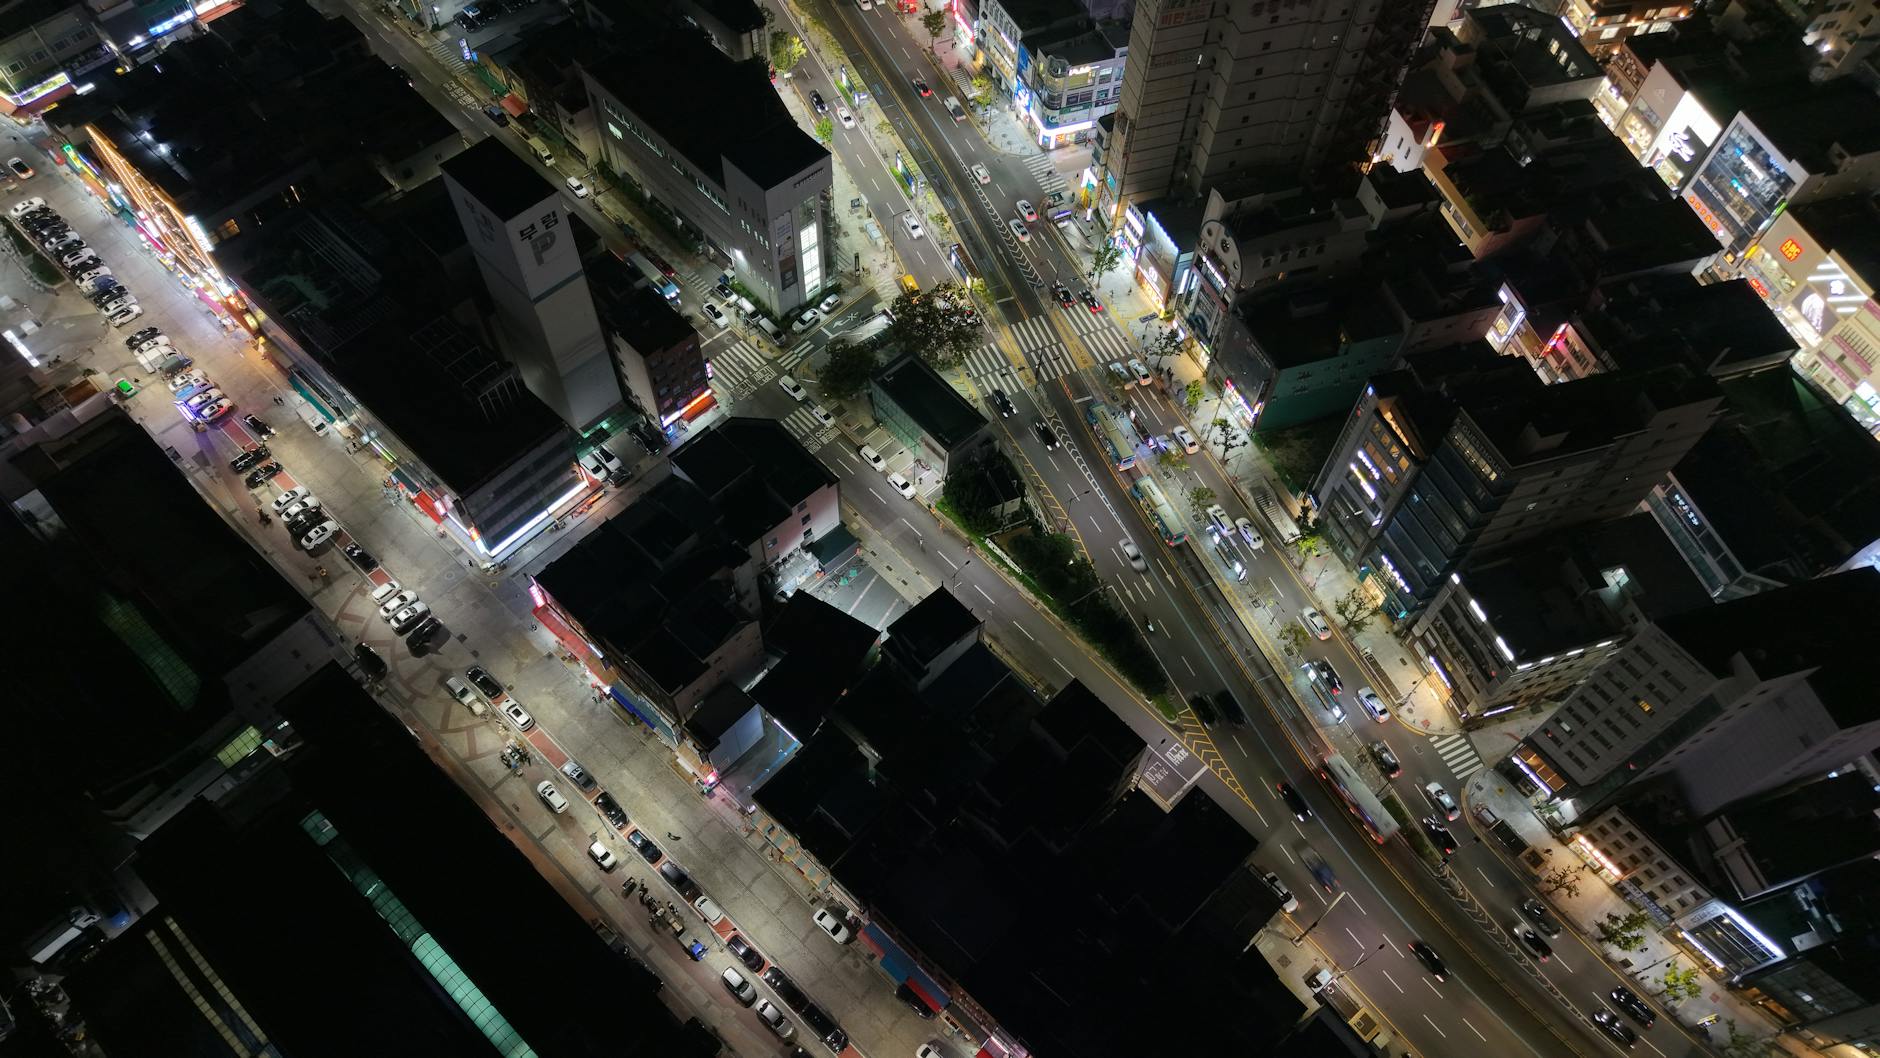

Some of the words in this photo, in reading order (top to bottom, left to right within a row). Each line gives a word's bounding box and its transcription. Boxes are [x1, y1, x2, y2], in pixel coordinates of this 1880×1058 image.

[519, 210, 558, 241] 부림
[531, 231, 556, 266] P
[1782, 239, 1801, 256] ABC
